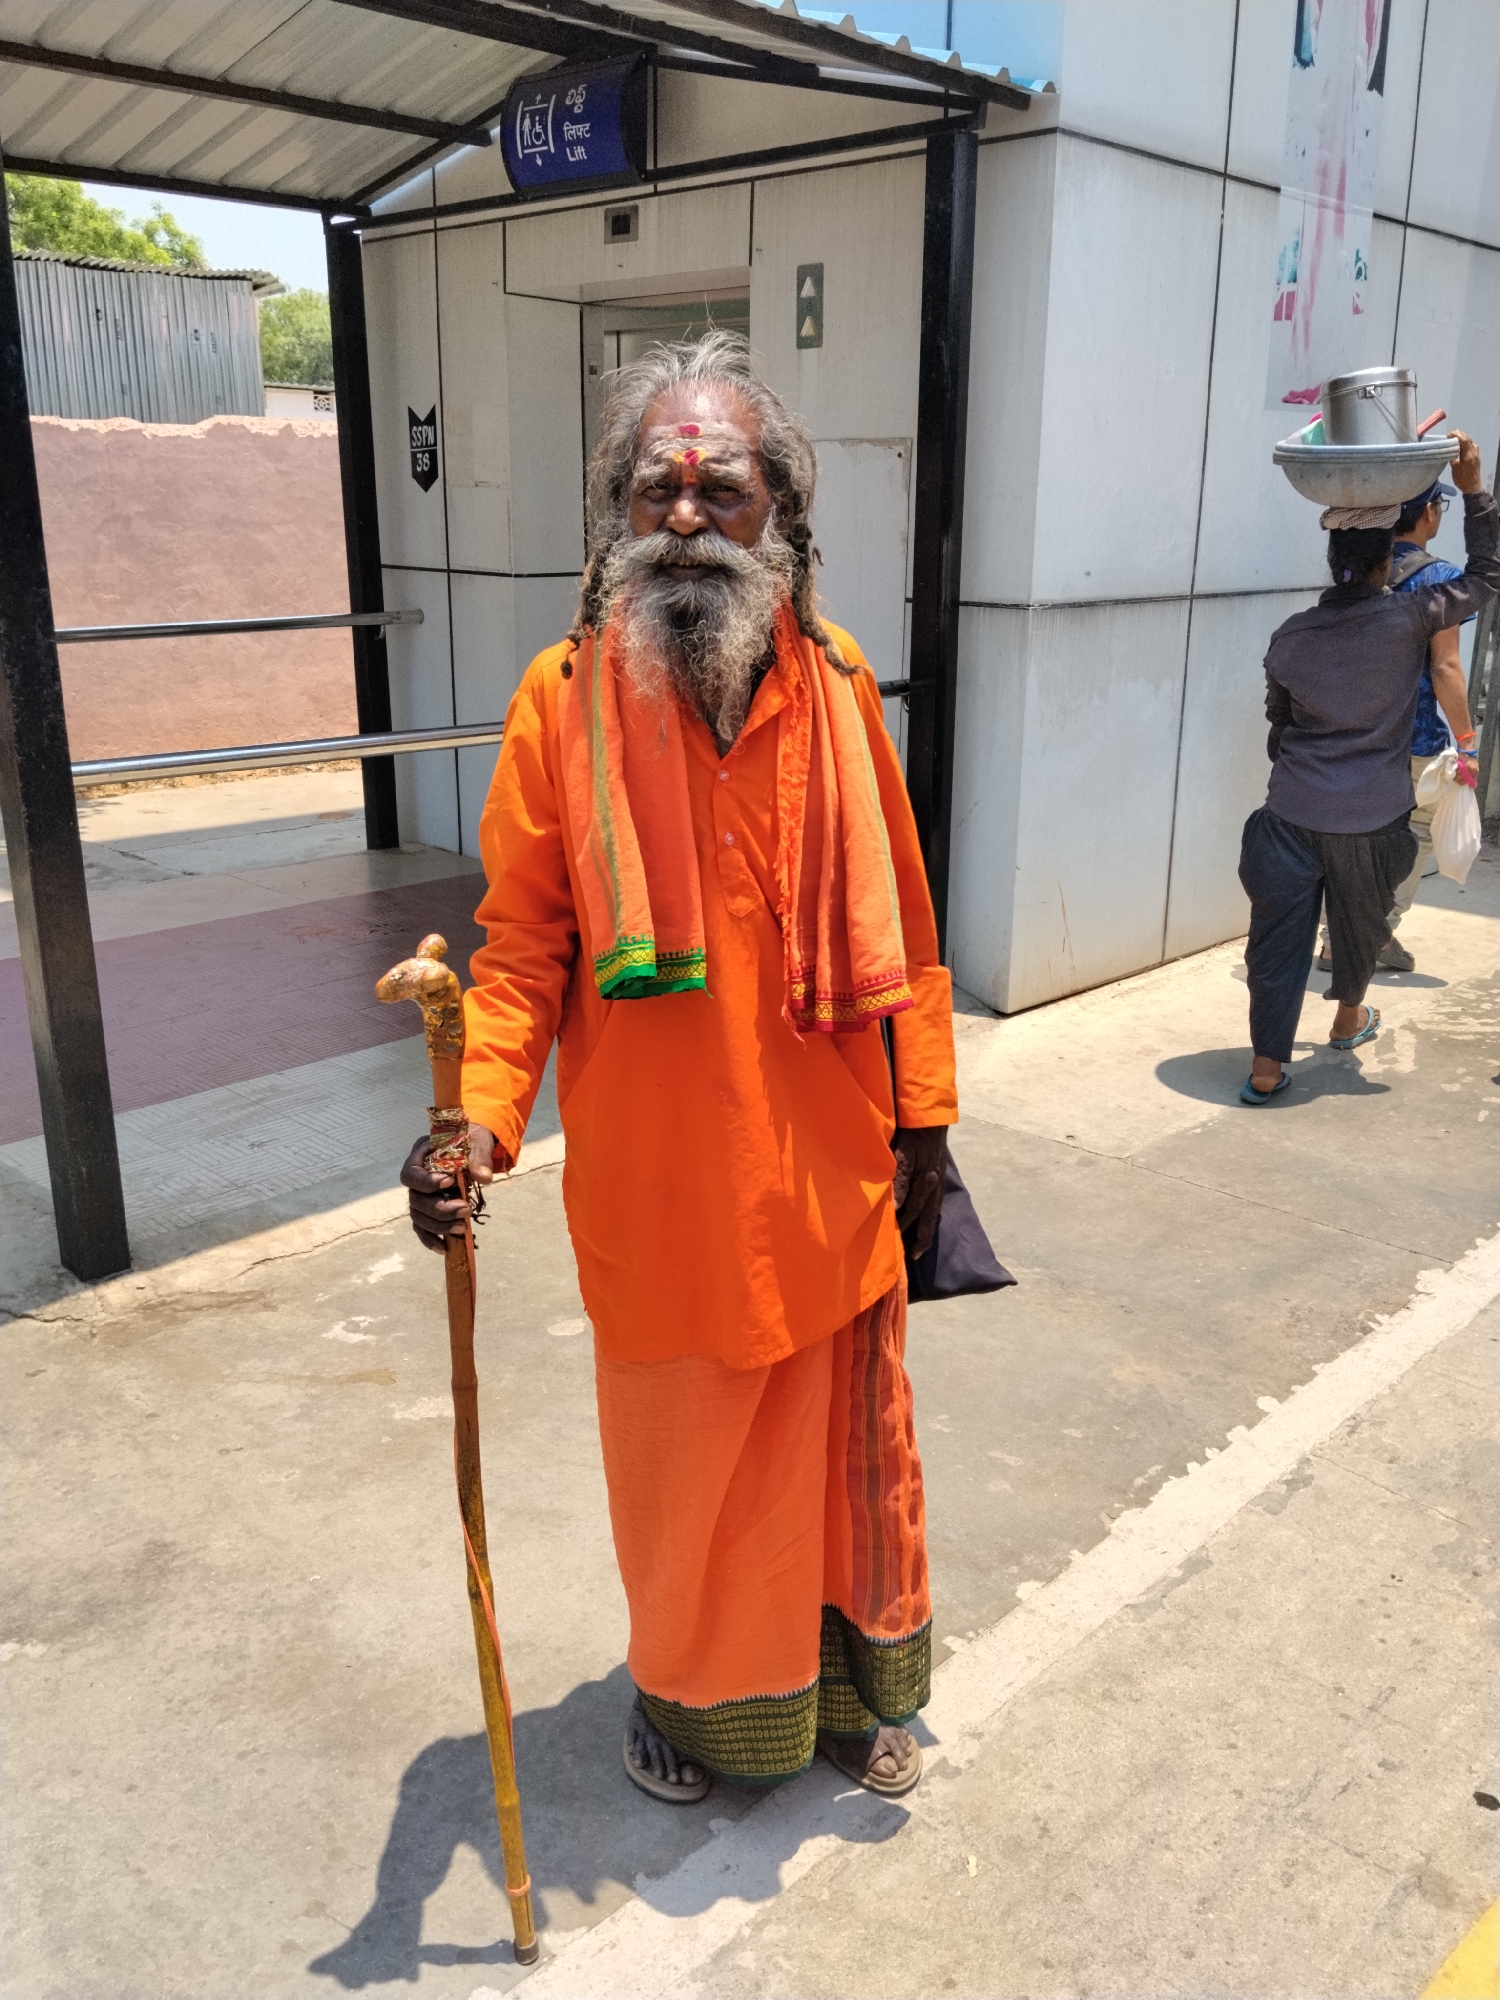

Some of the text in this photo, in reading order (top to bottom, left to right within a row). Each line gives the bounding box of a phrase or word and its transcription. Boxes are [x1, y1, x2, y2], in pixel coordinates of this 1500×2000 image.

[563, 121, 590, 141] लिफ्ट
[566, 145, 587, 161] Lift
[411, 425, 434, 447] SSPN
[416, 453, 430, 471] 38
